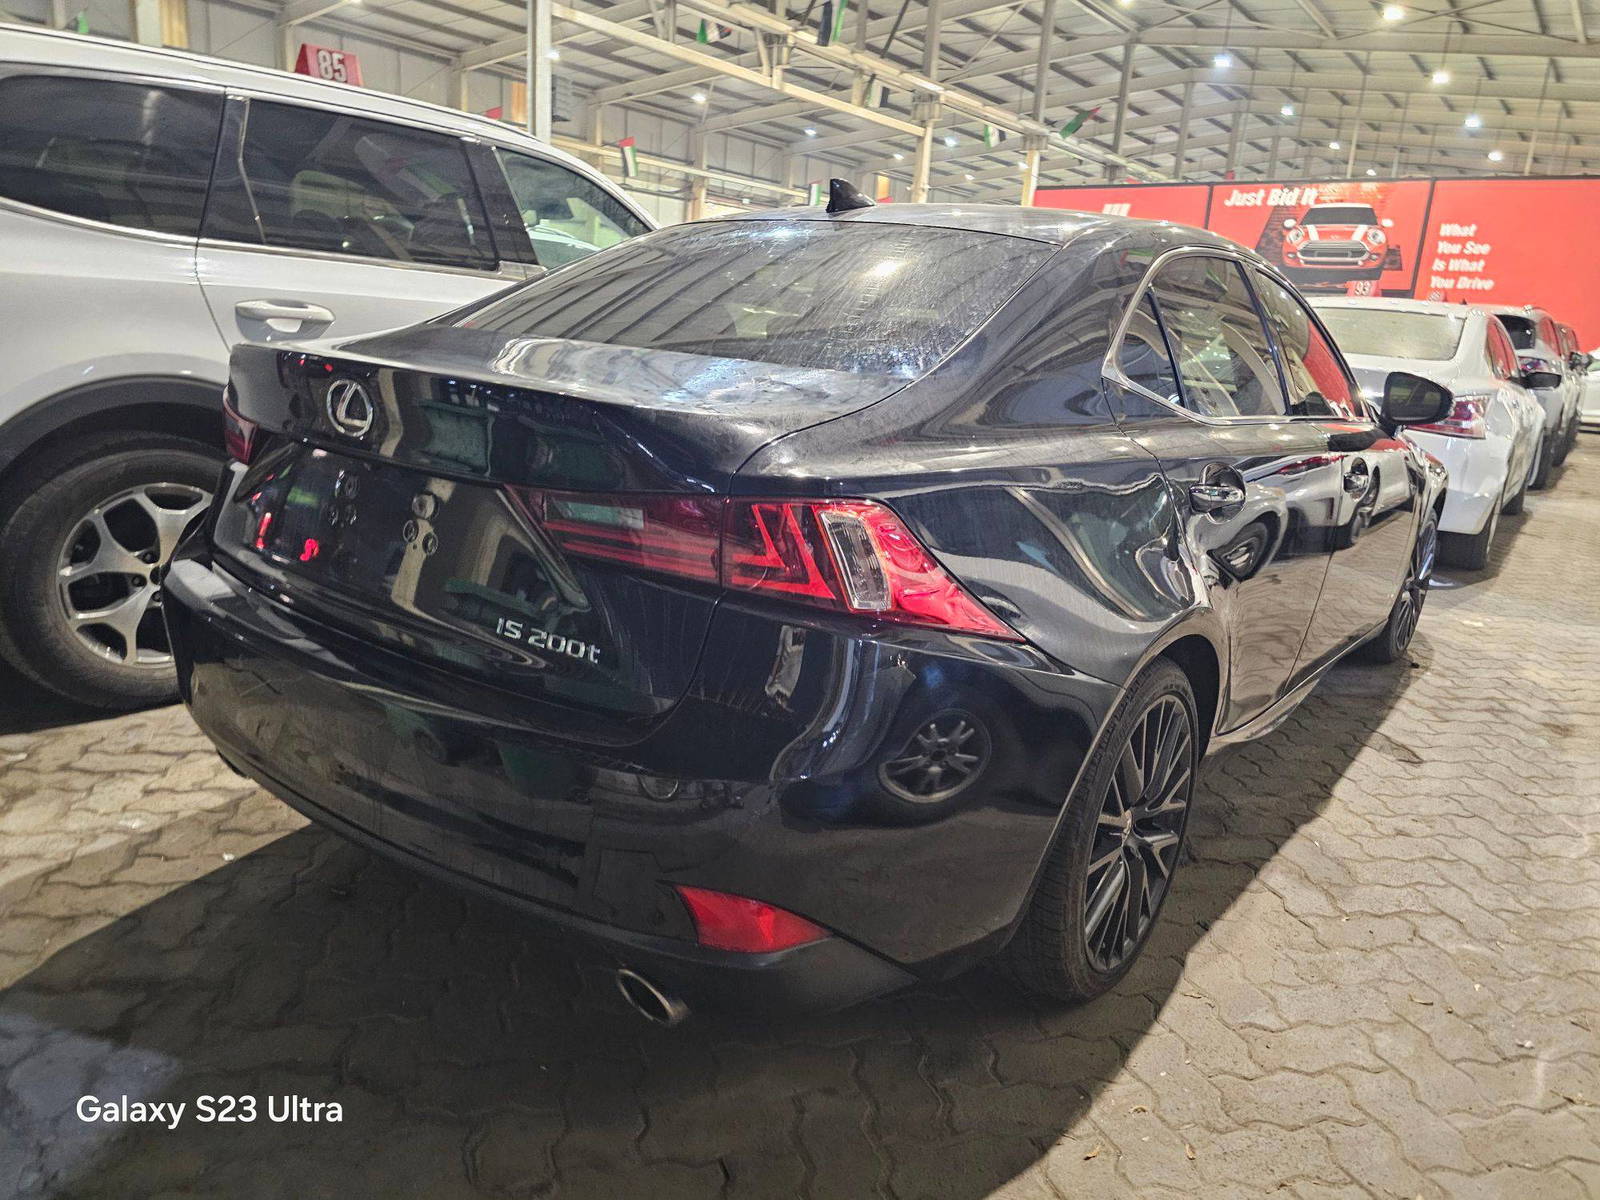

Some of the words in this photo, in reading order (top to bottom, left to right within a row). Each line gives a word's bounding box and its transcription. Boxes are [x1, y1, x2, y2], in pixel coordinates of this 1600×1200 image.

[317, 49, 348, 82] 85
[1224, 189, 1266, 206] Just
[1267, 187, 1300, 206] Bid
[1440, 223, 1477, 237] What
[1437, 240, 1462, 254] You
[1462, 240, 1491, 255] See
[1447, 258, 1485, 272] What
[1430, 275, 1455, 289] You
[1456, 276, 1495, 290] Drive
[496, 617, 523, 640] IS
[527, 627, 601, 664] 200t
